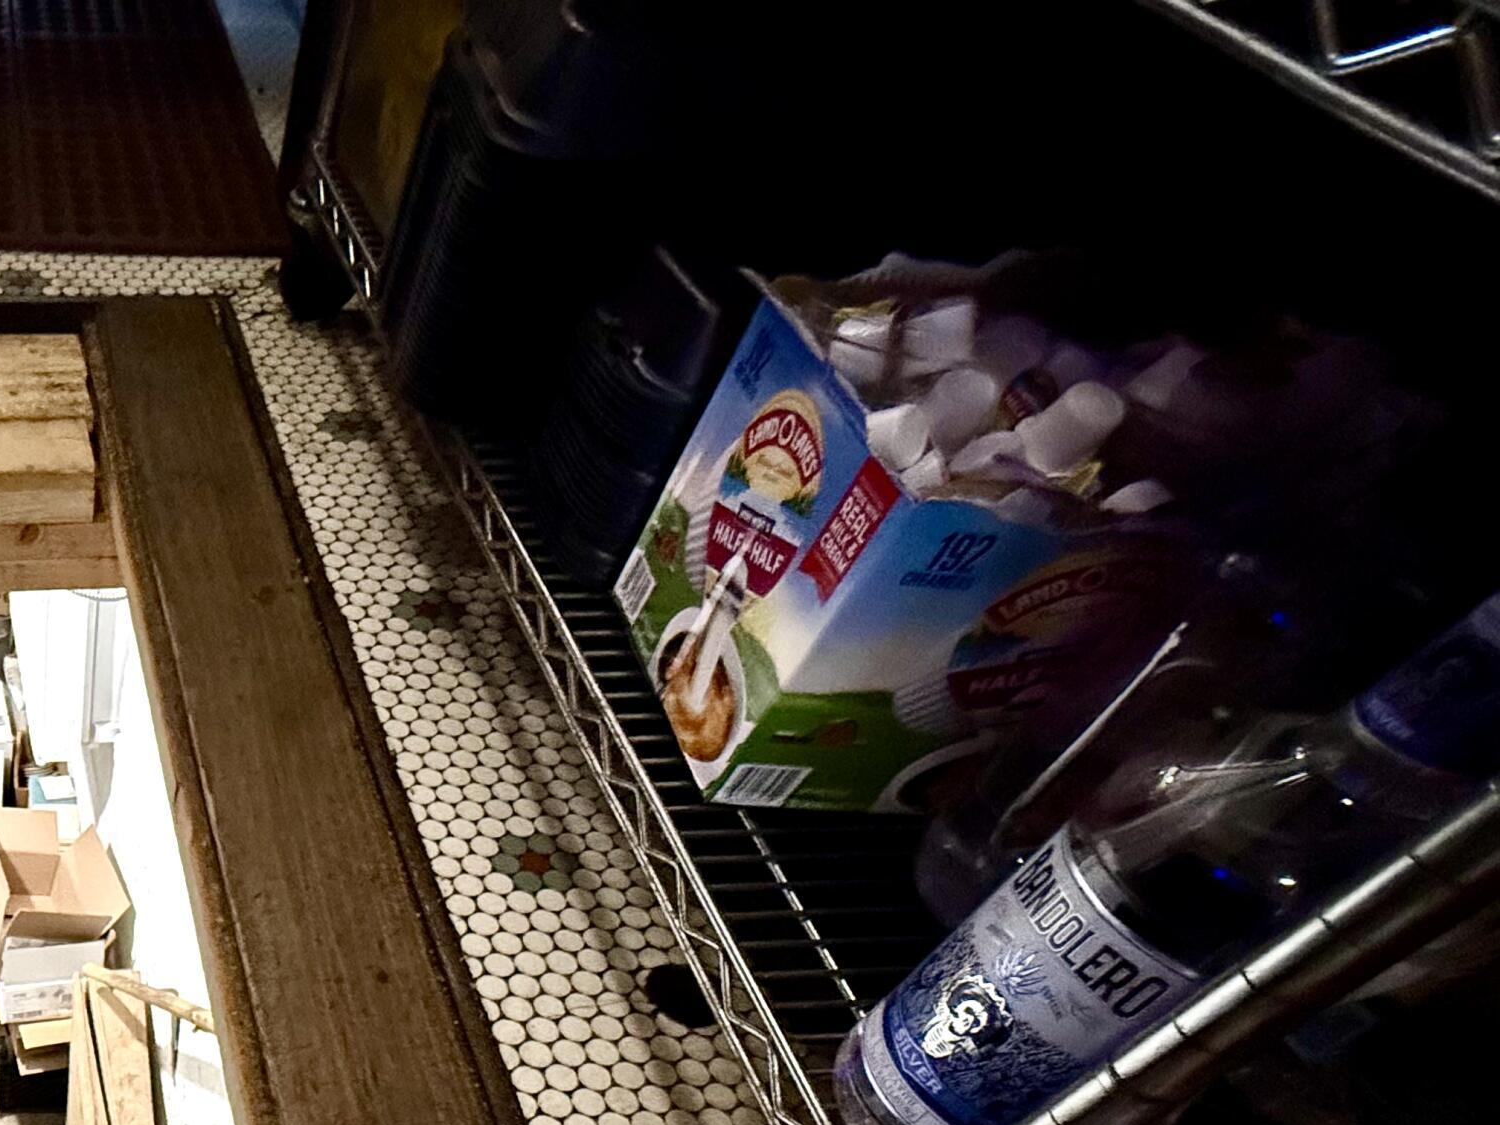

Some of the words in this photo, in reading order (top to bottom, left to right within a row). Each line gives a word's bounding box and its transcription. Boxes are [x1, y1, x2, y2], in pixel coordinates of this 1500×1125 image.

[749, 417, 780, 447] LAND
[790, 427, 819, 478] LAKES
[828, 516, 853, 548] MILK
[839, 496, 870, 544] REAL
[712, 520, 745, 553] HALF
[749, 541, 786, 574] HALF
[820, 532, 850, 573] CREAM
[925, 532, 997, 572] 192
[1013, 847, 1168, 1018] BANDOLERO
[895, 1027, 941, 1094] SILVER
